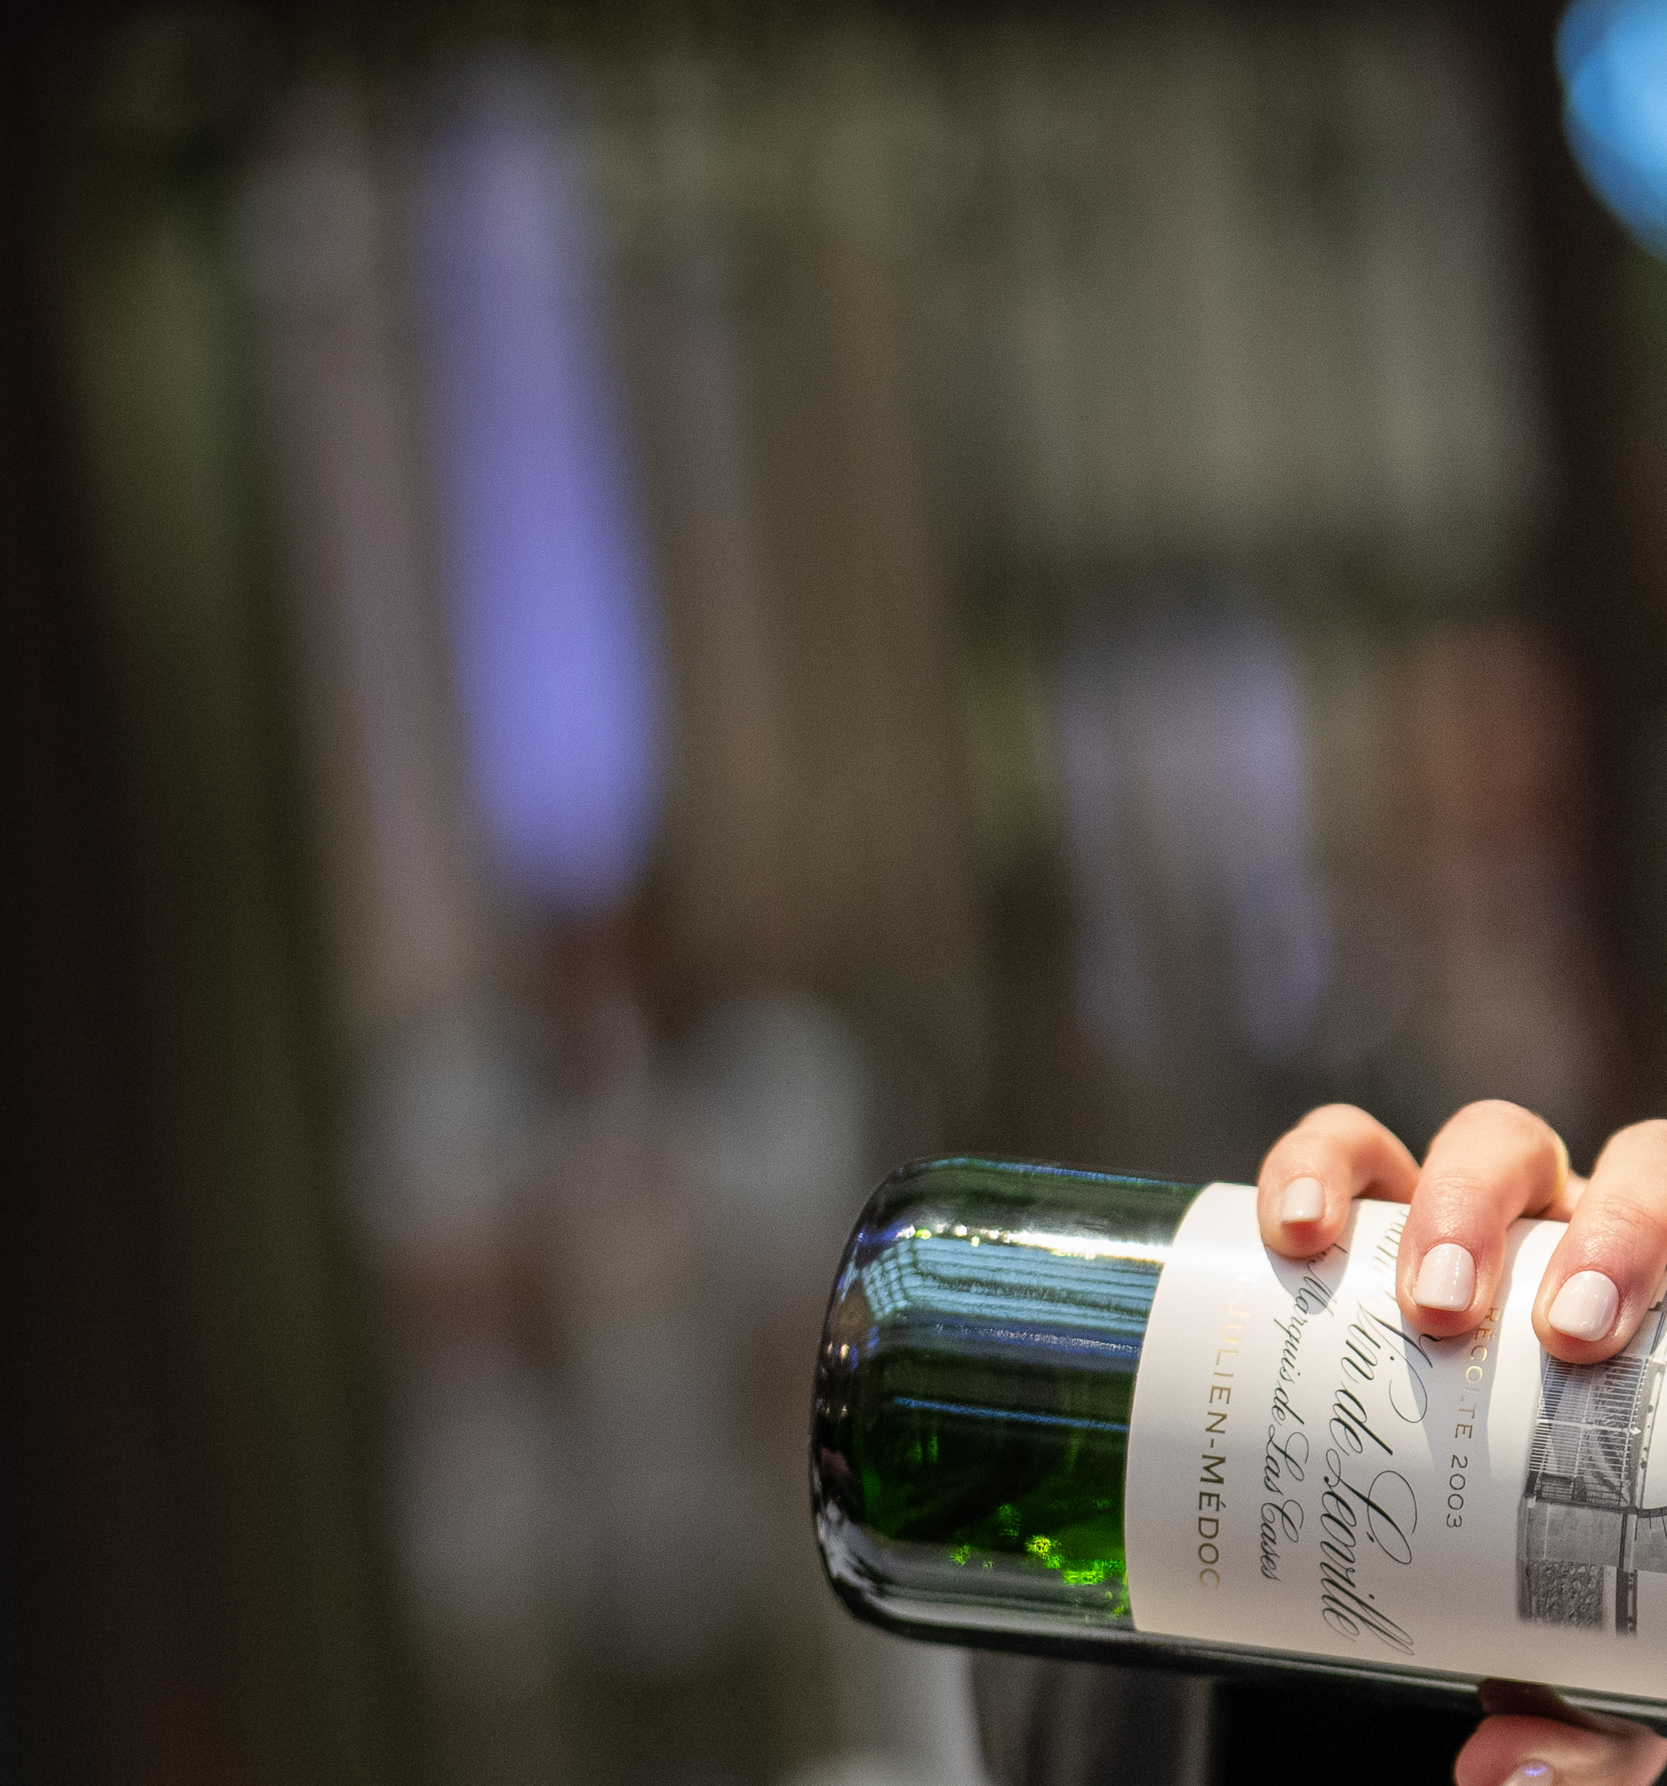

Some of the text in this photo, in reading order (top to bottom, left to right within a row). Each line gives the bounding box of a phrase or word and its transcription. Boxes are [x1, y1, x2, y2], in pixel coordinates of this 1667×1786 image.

[1273, 1259, 1338, 1384] Marquis
[1340, 1298, 1443, 1423] Vin
[1271, 1380, 1305, 1426] de
[1329, 1381, 1394, 1456] de
[1446, 1306, 1501, 1528] RÉCOLTE 2003
[1263, 1424, 1310, 1496] Las
[1260, 1498, 1305, 1583] Cases
[1320, 1448, 1418, 1656] Léoville
